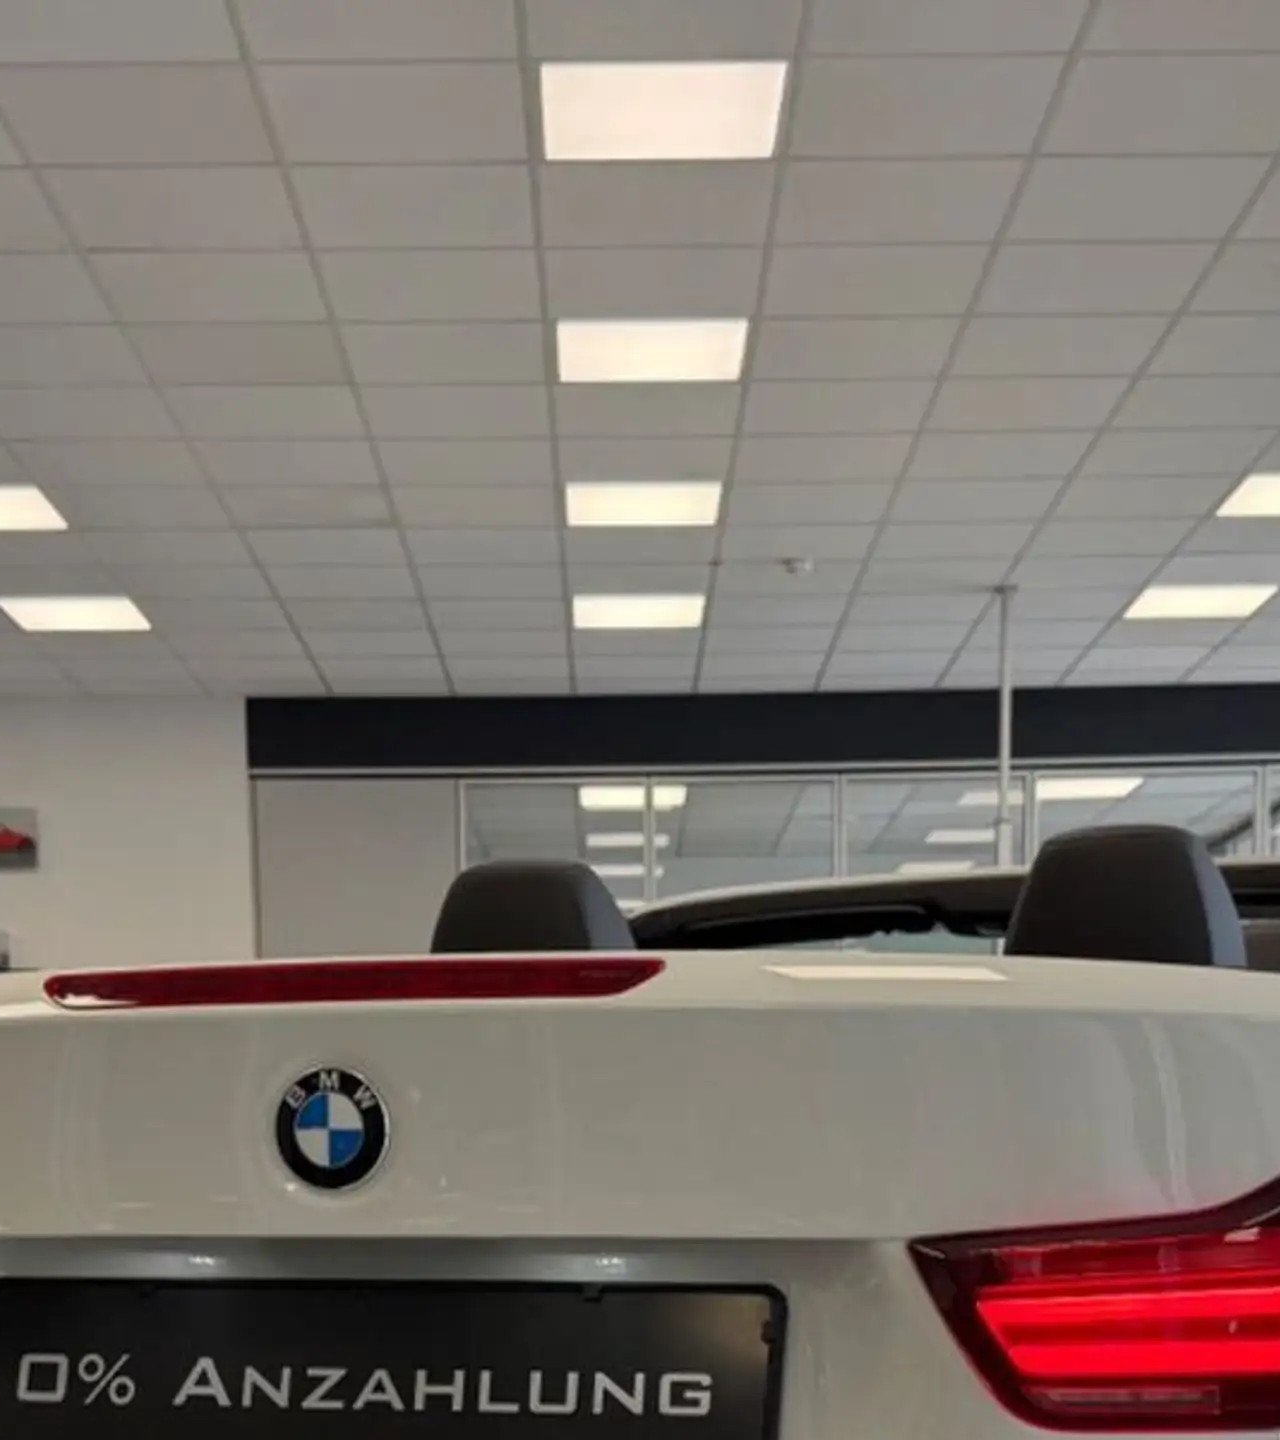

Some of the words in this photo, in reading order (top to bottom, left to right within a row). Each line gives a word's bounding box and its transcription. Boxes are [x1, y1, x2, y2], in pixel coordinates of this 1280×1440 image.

[284, 1069, 378, 1111] BMW
[16, 1353, 136, 1406] 0%
[173, 1356, 713, 1417] ANZAHLUNG
